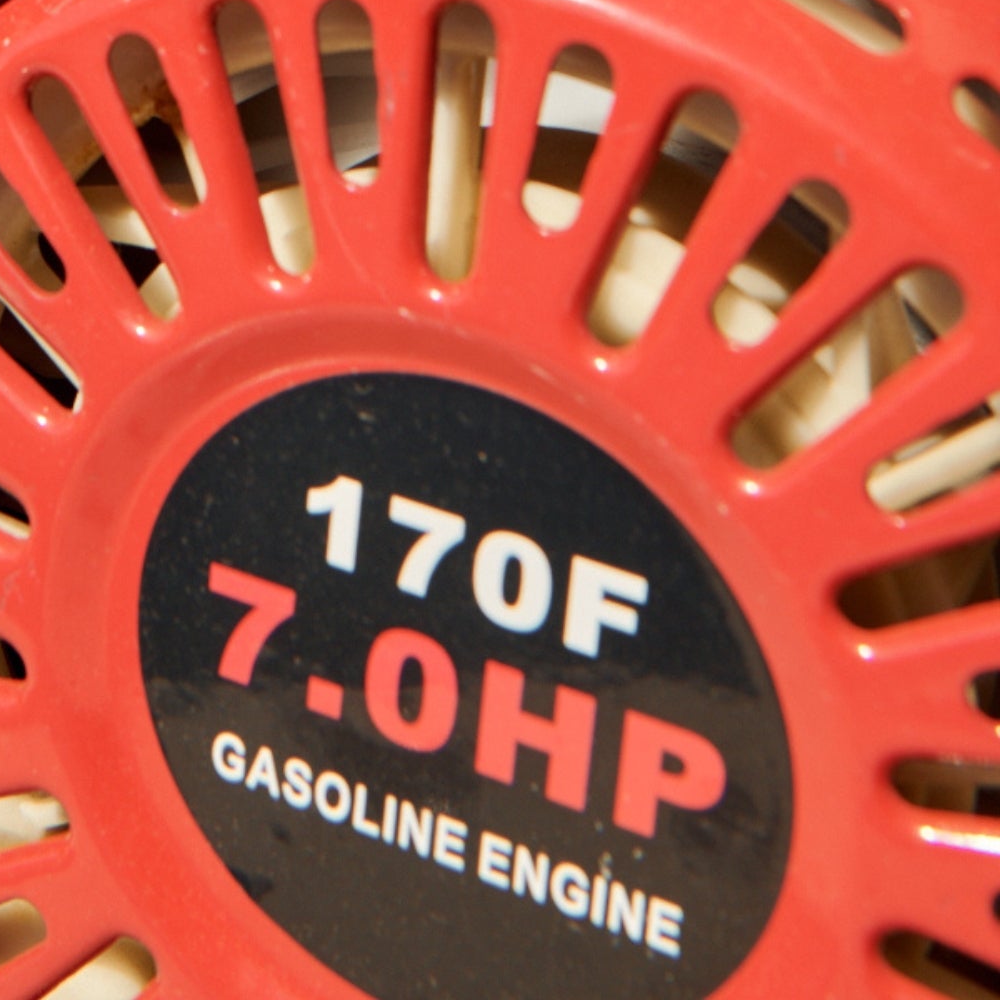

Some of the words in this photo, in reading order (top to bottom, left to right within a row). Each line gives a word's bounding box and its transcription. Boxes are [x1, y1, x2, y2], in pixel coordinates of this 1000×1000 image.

[306, 475, 648, 658] 170F
[208, 561, 726, 838] 7.0HP
[211, 732, 467, 871] GASOLINE
[478, 831, 684, 957] ENGINE
